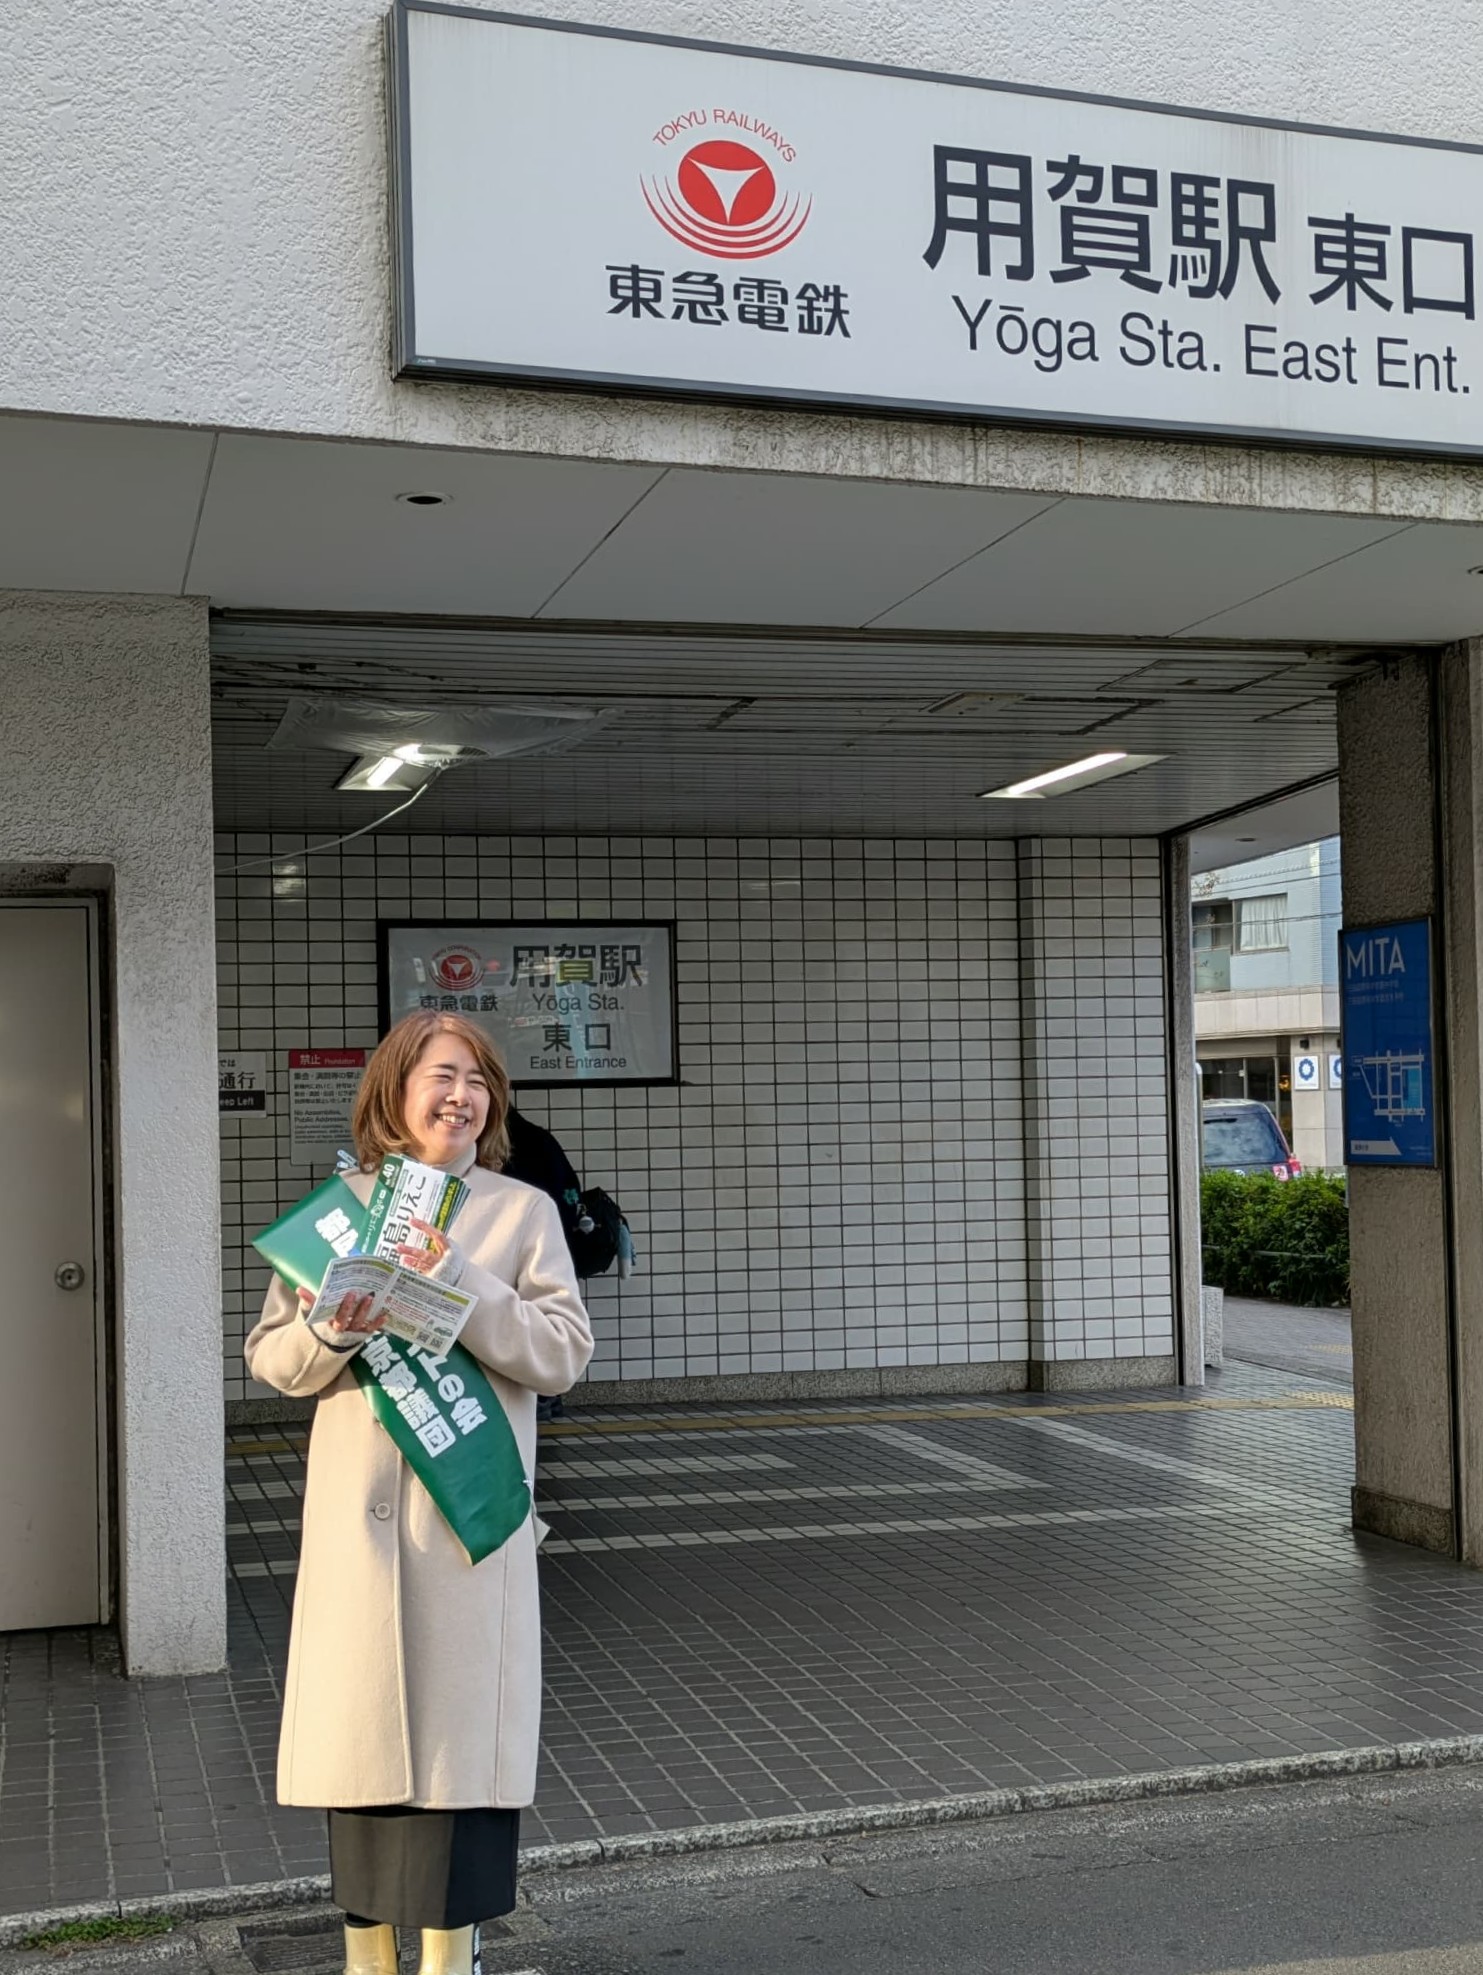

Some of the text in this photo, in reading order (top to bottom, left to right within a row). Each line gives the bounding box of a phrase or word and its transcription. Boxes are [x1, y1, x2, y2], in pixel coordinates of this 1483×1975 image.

[652, 108, 797, 163] TOKYU RAILWAYS
[922, 143, 1476, 321] 用賀駅 東口
[604, 263, 852, 338] 東急電鉄
[951, 294, 1470, 394] Yōga Sta. East Ent.
[509, 943, 643, 988] 用賀駅
[1346, 936, 1406, 980] MITA
[419, 994, 499, 1012] 東急電鉄
[532, 993, 625, 1015] Yōga Sta.
[543, 1023, 612, 1052] 東口
[530, 1056, 627, 1069] East Entrance
[237, 1096, 255, 1106] Left
[360, 1334, 456, 1459] 京都議団
